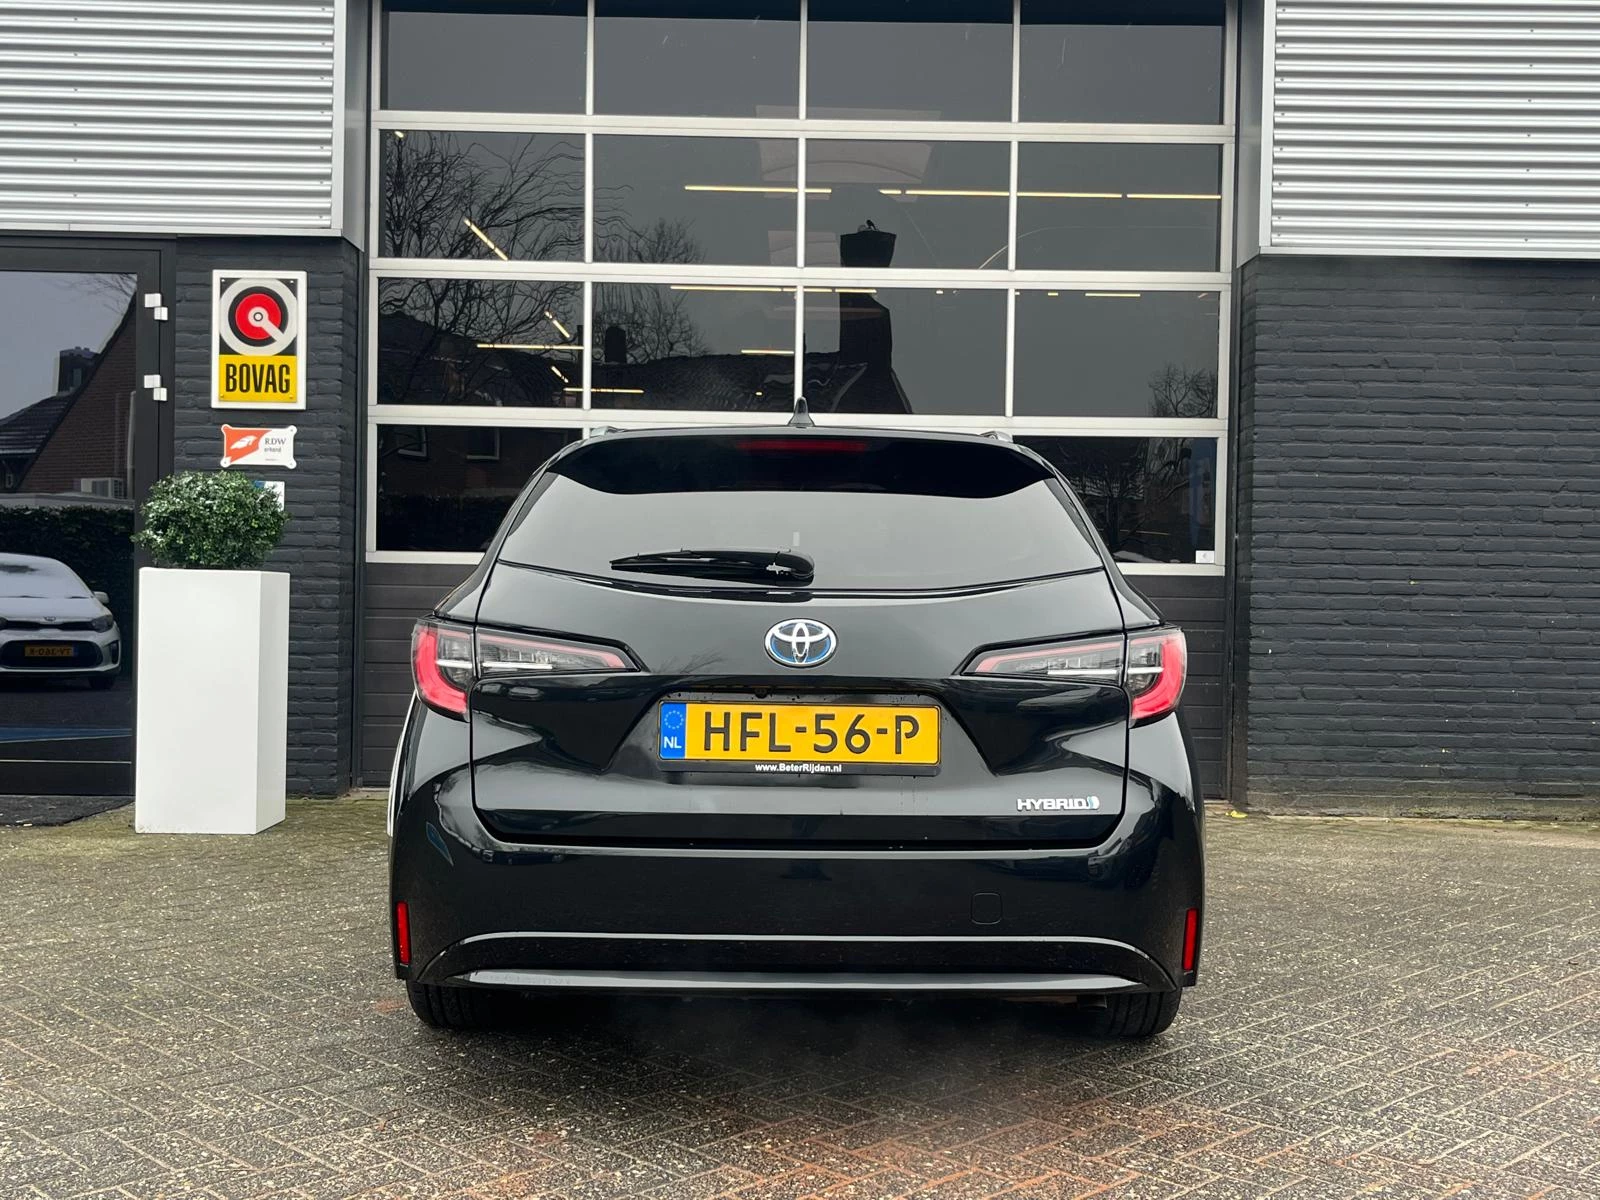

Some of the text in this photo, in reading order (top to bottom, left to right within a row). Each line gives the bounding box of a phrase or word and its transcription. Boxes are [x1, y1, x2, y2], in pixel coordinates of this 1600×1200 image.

[225, 363, 291, 394] BOVAG
[264, 437, 287, 445] RDW
[704, 711, 919, 755] HFL-56-P
[663, 736, 682, 749] NL
[755, 763, 842, 773] www.BeterRijden.nl
[1017, 798, 1088, 810] HYBRID
